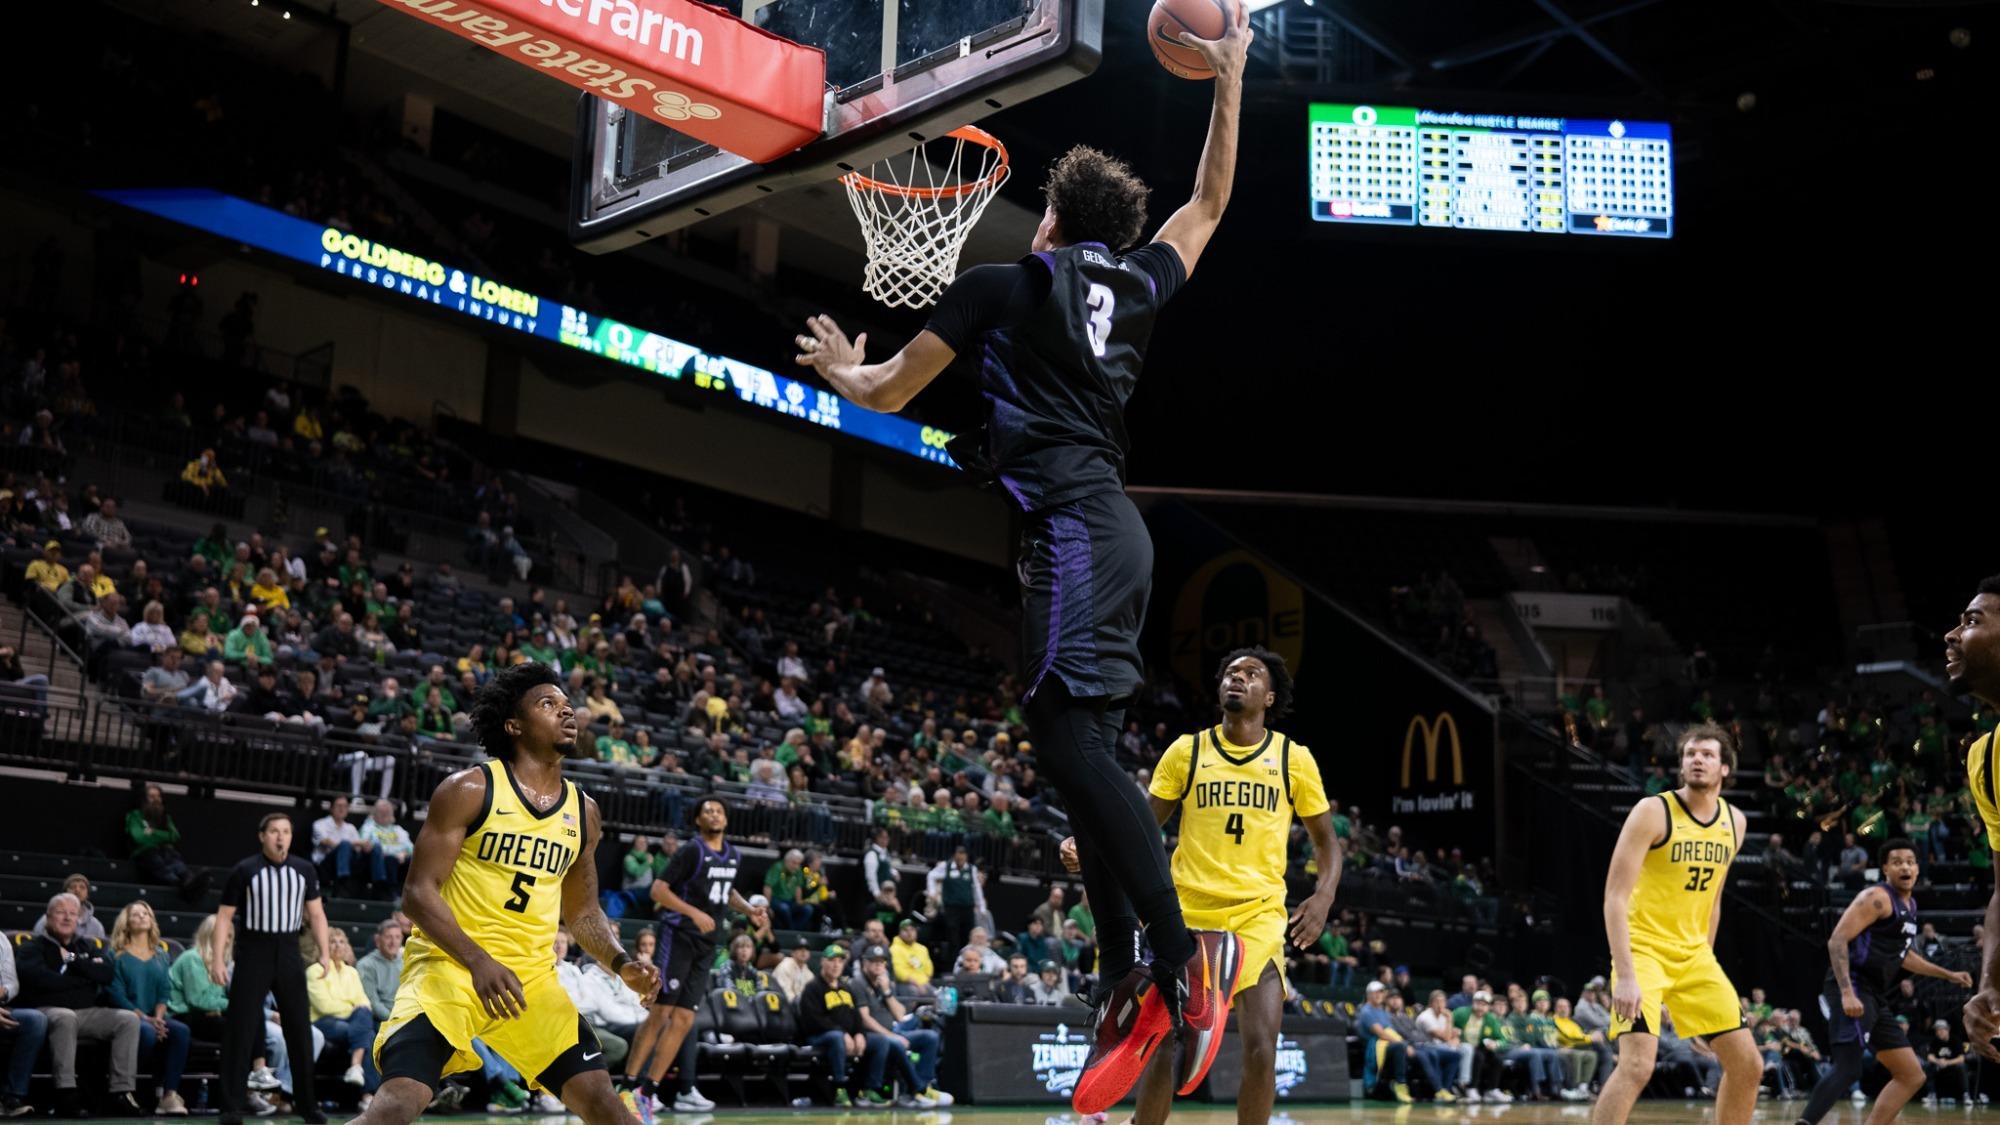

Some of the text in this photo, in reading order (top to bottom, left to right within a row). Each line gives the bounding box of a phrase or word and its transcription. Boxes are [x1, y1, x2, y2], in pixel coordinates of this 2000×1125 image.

[538, 0, 703, 66] Farm
[321, 227, 539, 318] GOLDBERG & LOREN
[1082, 249, 1117, 269] GEO
[320, 253, 441, 304] PERSONAL
[458, 298, 537, 333] INJURY
[1086, 283, 1115, 357] 3
[1196, 781, 1280, 813] OREGON
[1225, 813, 1244, 845] 4
[477, 831, 574, 878] OREGON
[1671, 841, 1732, 866] OREGON
[503, 871, 537, 914] 5
[1684, 866, 1715, 891] 32
